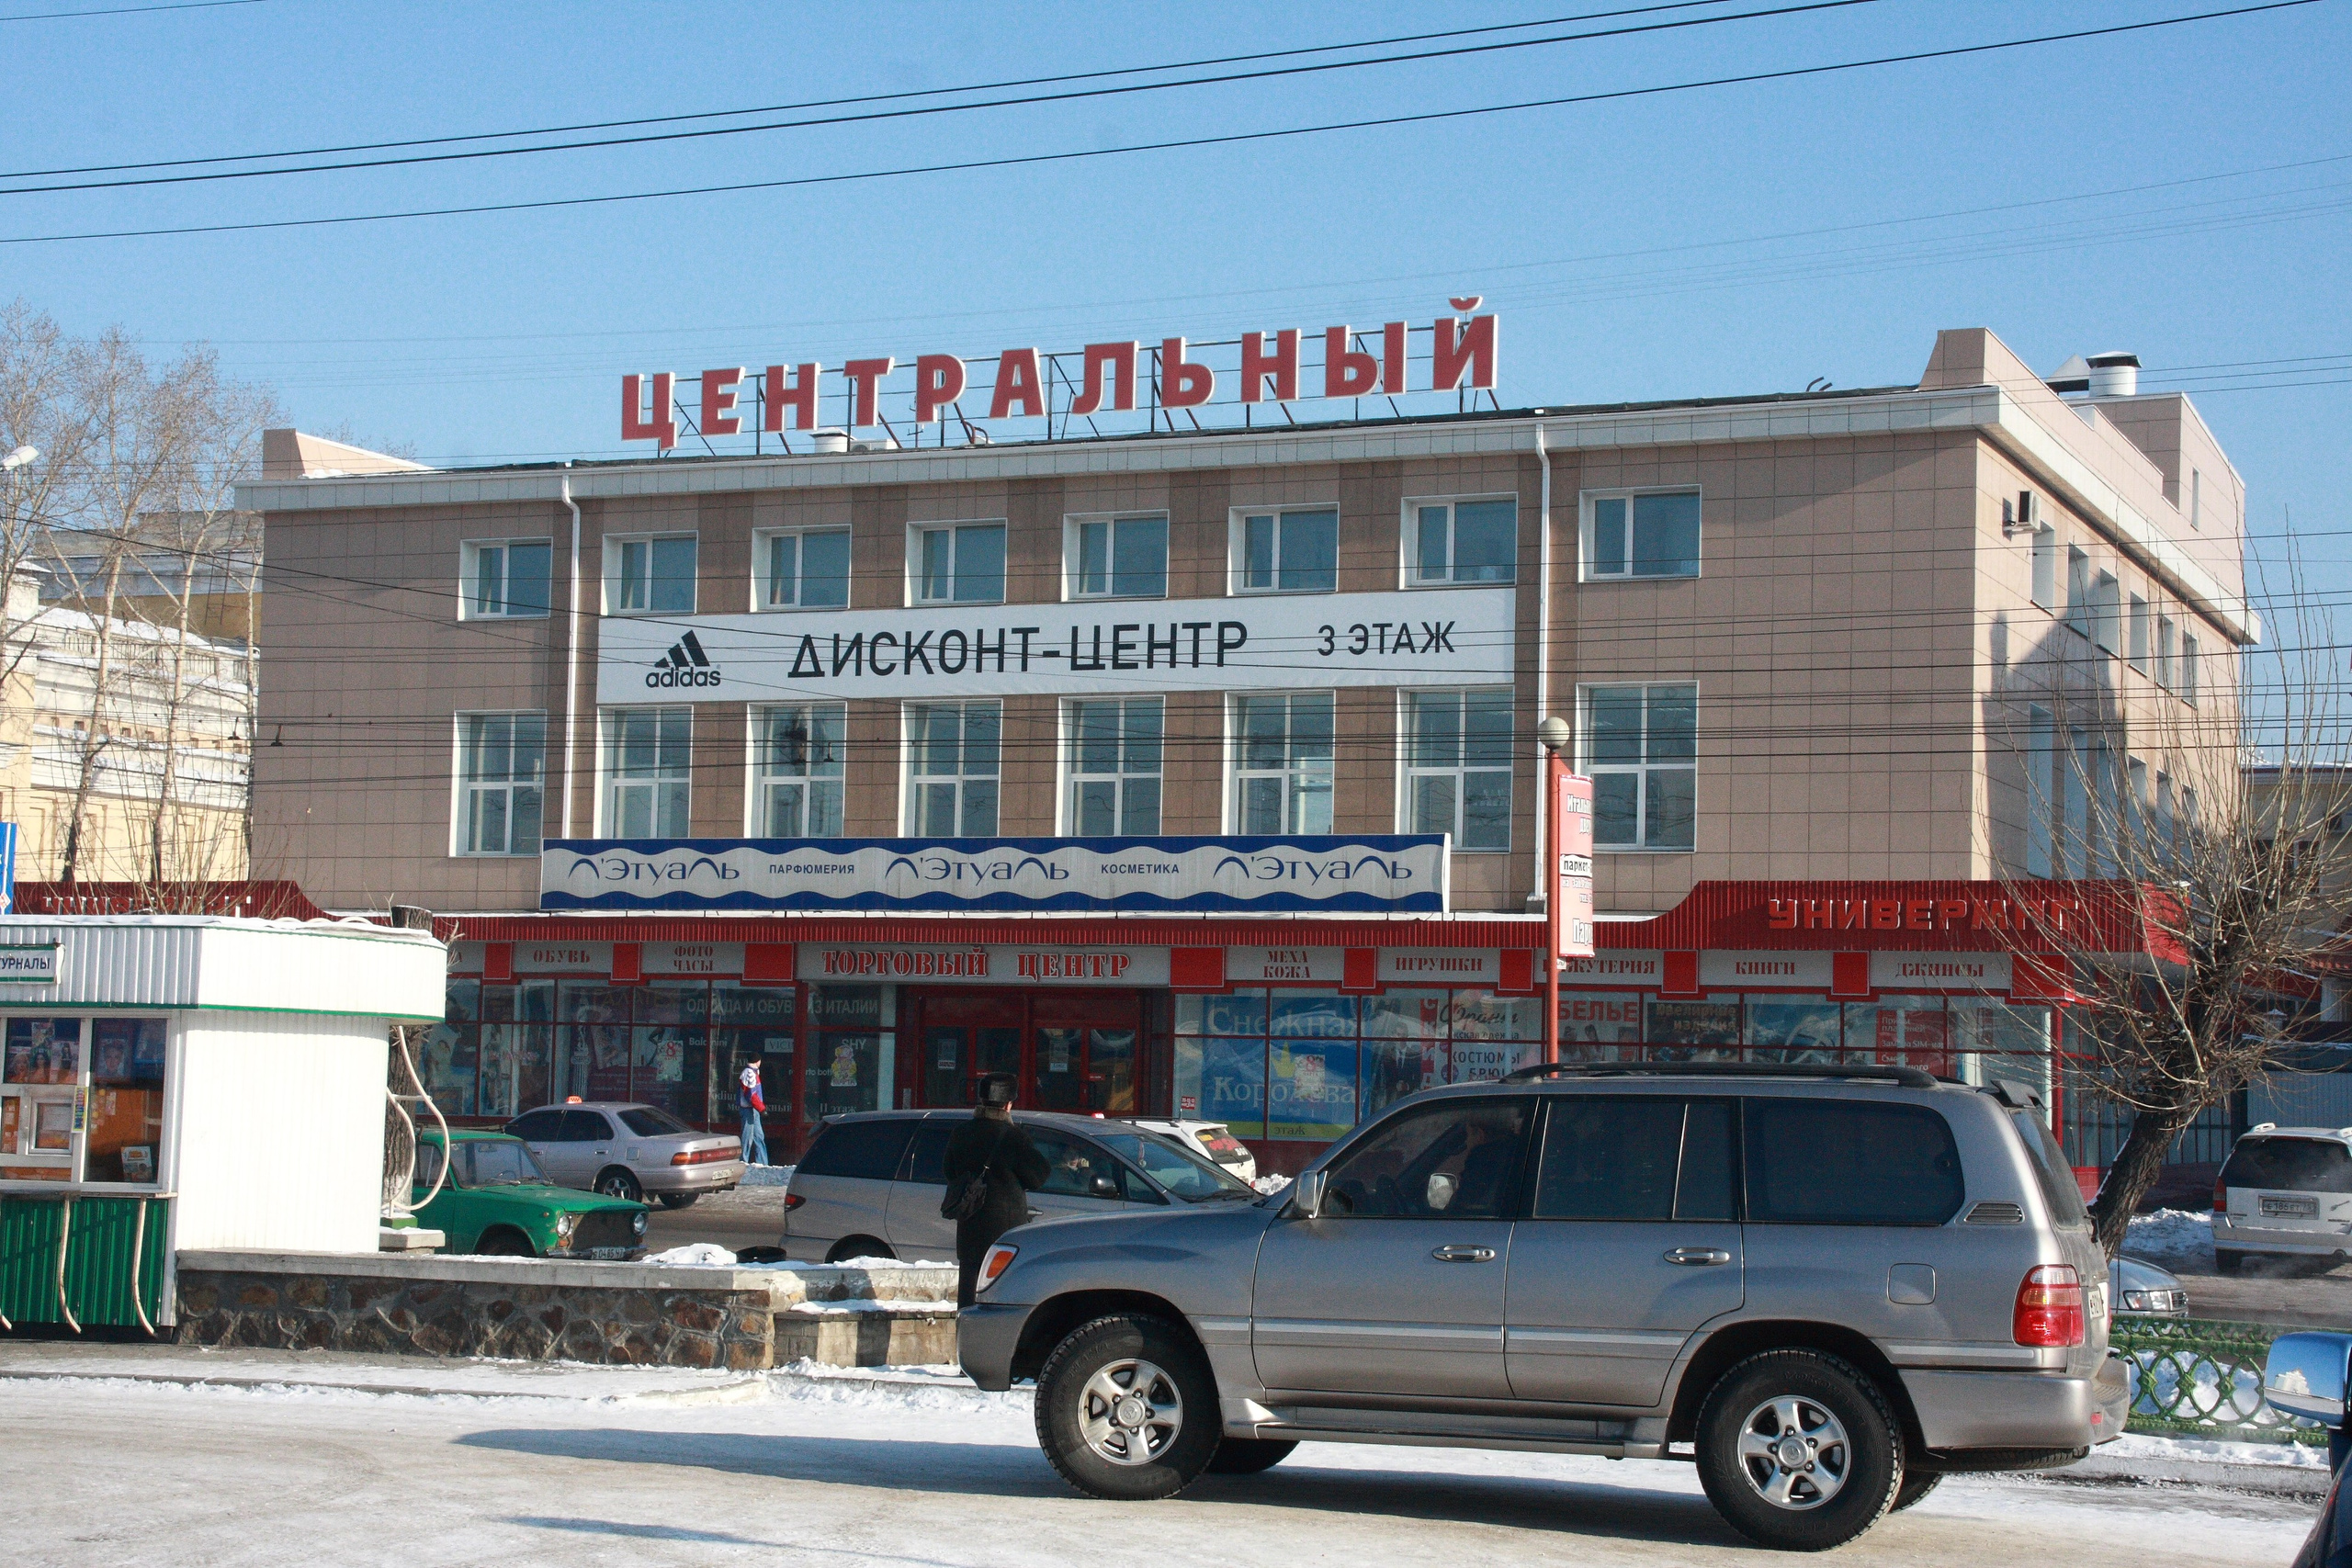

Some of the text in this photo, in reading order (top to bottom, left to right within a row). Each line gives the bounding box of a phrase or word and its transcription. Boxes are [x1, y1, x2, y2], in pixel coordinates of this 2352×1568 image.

[622, 296, 1498, 449] ЦЕНТРАЛЬНЫЙ
[1317, 621, 1455, 656] 3 ЭТАЖ
[787, 620, 1248, 678] ДИСКОНТ-ЦЕНТР
[645, 664, 721, 688] adidas
[768, 863, 855, 875] ПАРФЮМЕРИЯ
[1101, 863, 1180, 874] КОСМЕТИКА
[1769, 899, 2079, 931] УНИВЕРМАГ
[533, 949, 591, 964] ОБУВЬ
[674, 945, 714, 957] ФОТО
[1267, 950, 1308, 964] МЕХА
[0, 957, 51, 970] УРНАЛЫ
[673, 958, 714, 972] ЧАСЫ
[820, 946, 1131, 983] ТОРГОВЫЙ ЦЕНТР
[1395, 956, 1483, 972] ИГРУШКИ
[1736, 961, 1795, 976] КНИГИ
[1895, 963, 1984, 978] ДЖИНСЫ
[1263, 964, 1311, 979] КОЖА
[686, 998, 741, 1015] ОДДА
[826, 1000, 878, 1015] ИТАЛИИ
[1557, 1000, 1638, 1022] БЕЛЬЕ
